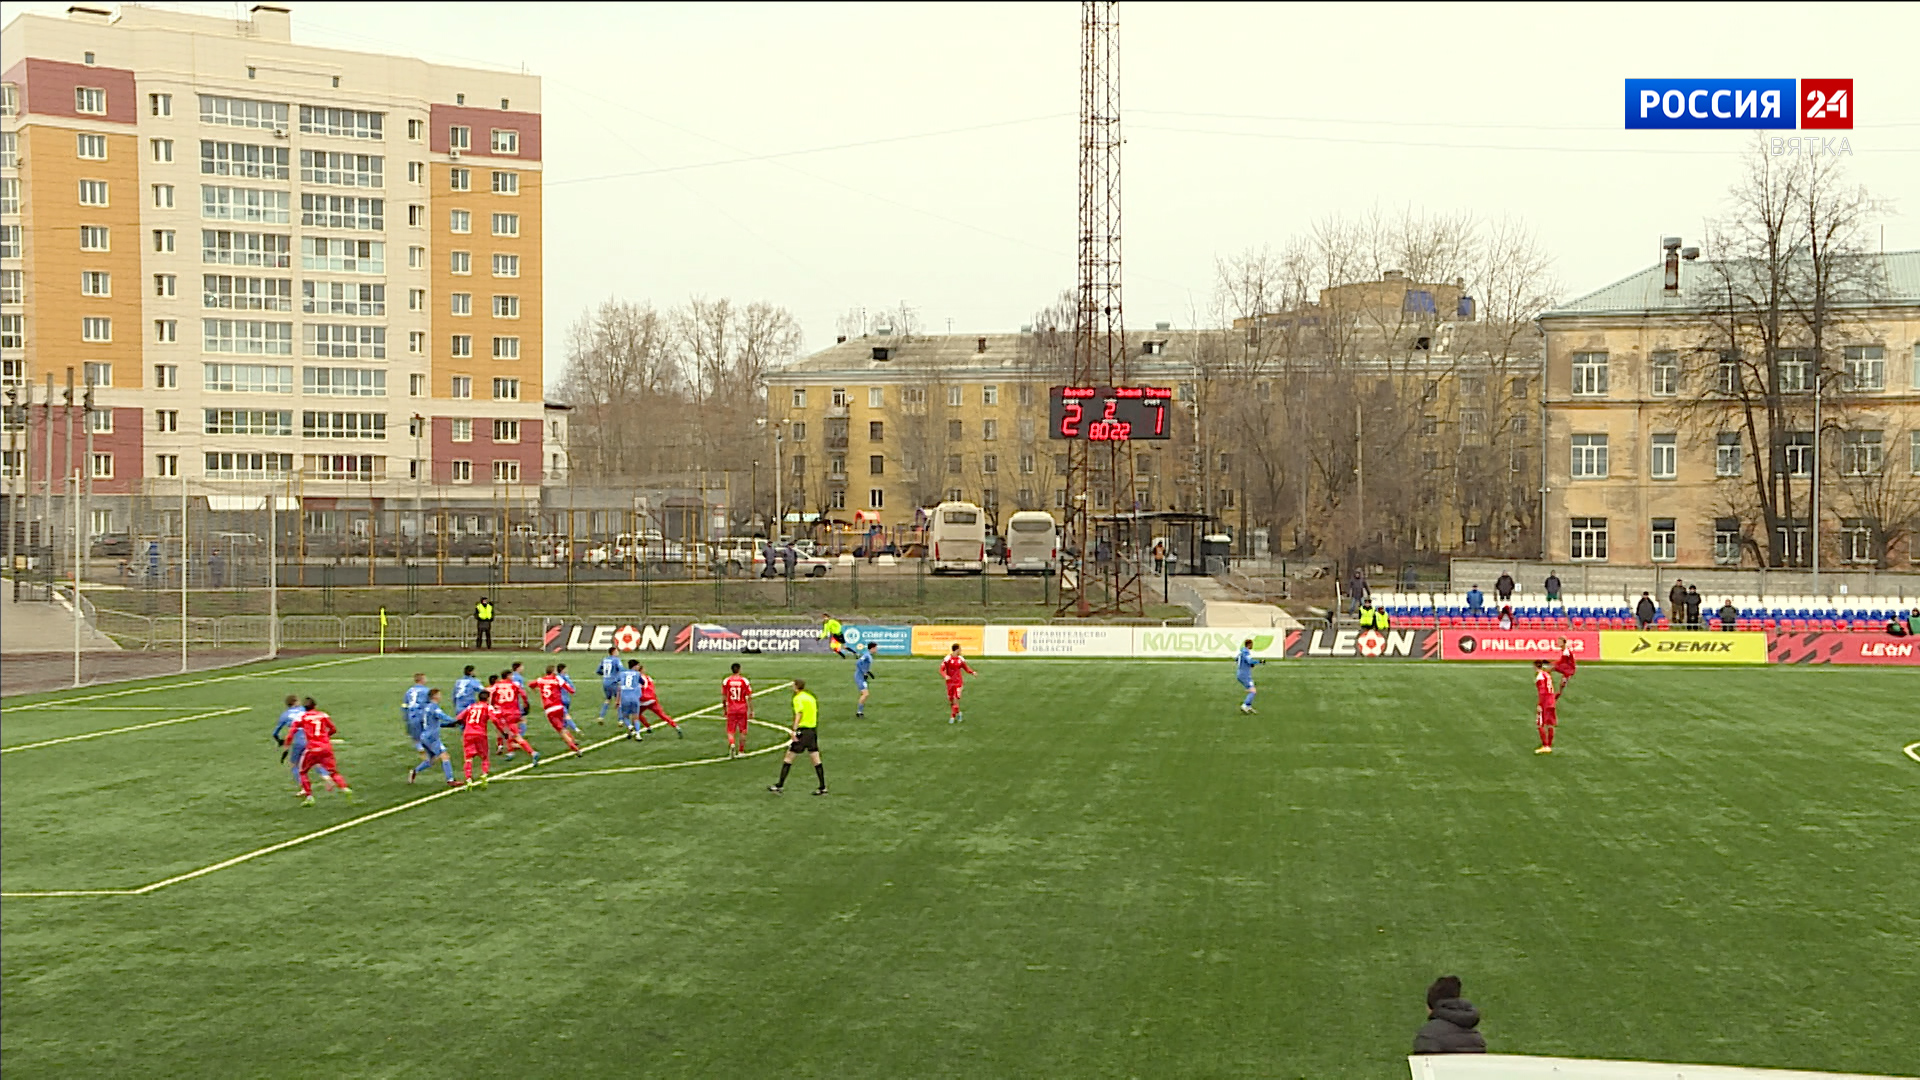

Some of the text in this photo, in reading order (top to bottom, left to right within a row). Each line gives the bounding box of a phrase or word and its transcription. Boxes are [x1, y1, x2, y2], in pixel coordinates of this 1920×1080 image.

[1104, 402, 1115, 418] 2
[1062, 405, 1081, 435] 2
[567, 625, 670, 651] LEON
[697, 639, 800, 651] #МЫРОССИЯ
[1143, 632, 1238, 651] КИБИХ
[1308, 629, 1415, 656] LEON
[1656, 641, 1734, 652] DEMIX
[1861, 643, 1913, 656] LEON
[543, 685, 552, 698] 5
[729, 687, 741, 701] 31
[468, 709, 482, 724] 21
